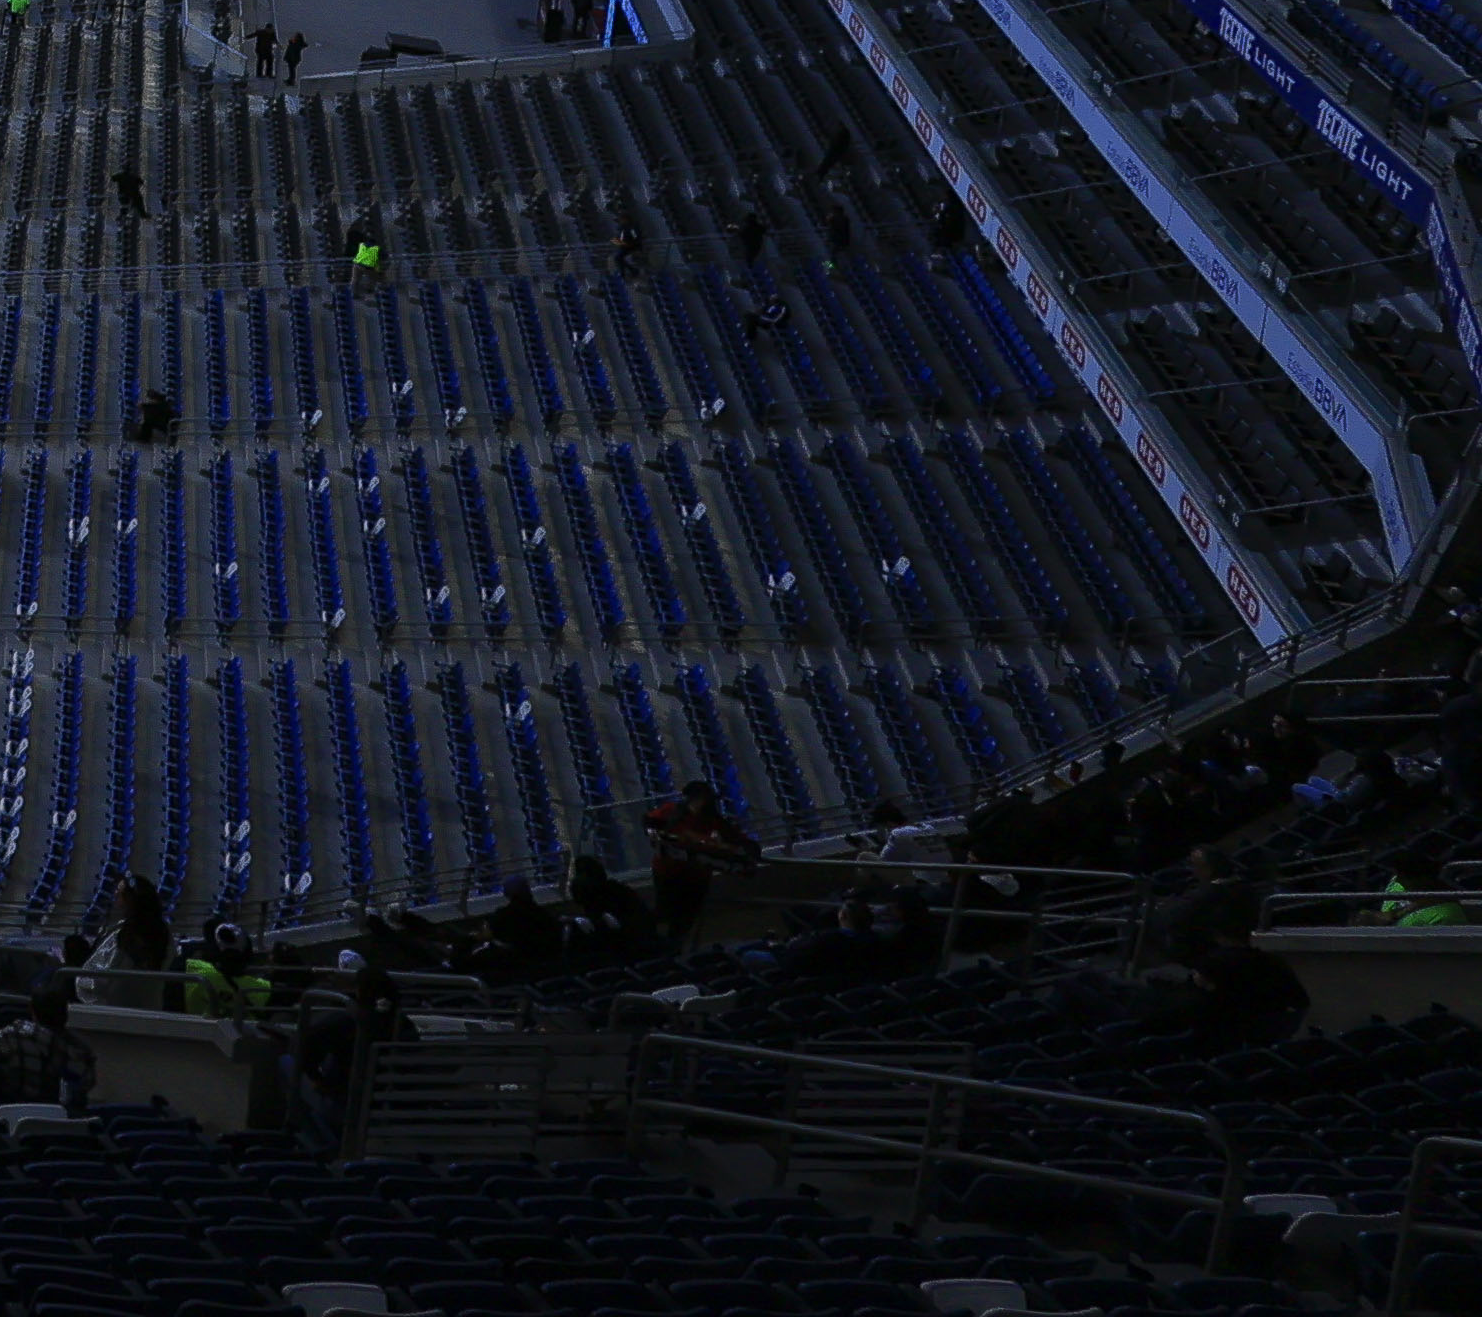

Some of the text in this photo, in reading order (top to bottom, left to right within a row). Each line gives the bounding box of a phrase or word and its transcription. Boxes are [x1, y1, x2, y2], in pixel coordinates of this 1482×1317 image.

[1219, 5, 1297, 94] TECATE LIGHT
[1316, 98, 1415, 201] TECATE LIGHT
[1210, 259, 1241, 306] BBVA
[1313, 377, 1348, 432] BBVA
